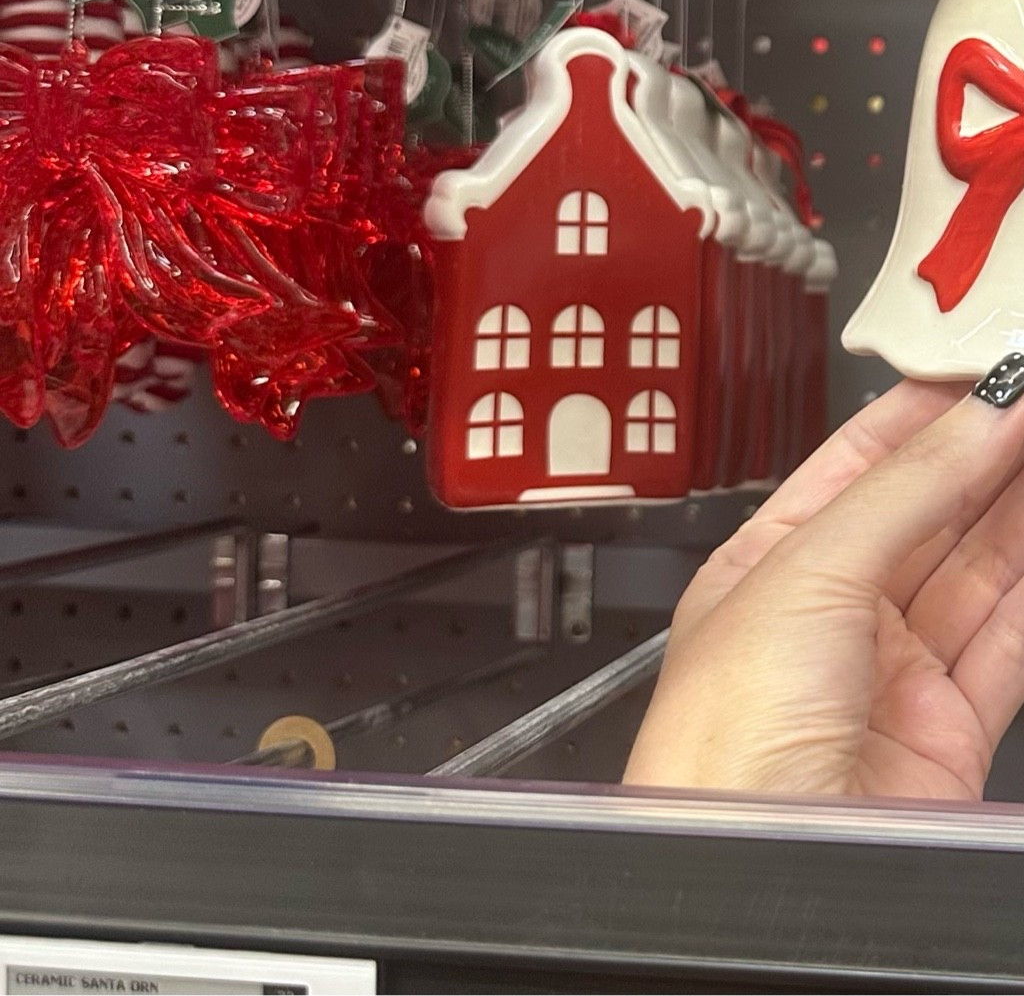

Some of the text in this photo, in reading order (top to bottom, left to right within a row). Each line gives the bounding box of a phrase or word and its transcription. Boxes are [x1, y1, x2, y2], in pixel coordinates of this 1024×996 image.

[16, 972, 160, 993] CERAMIC SANTA ORN
